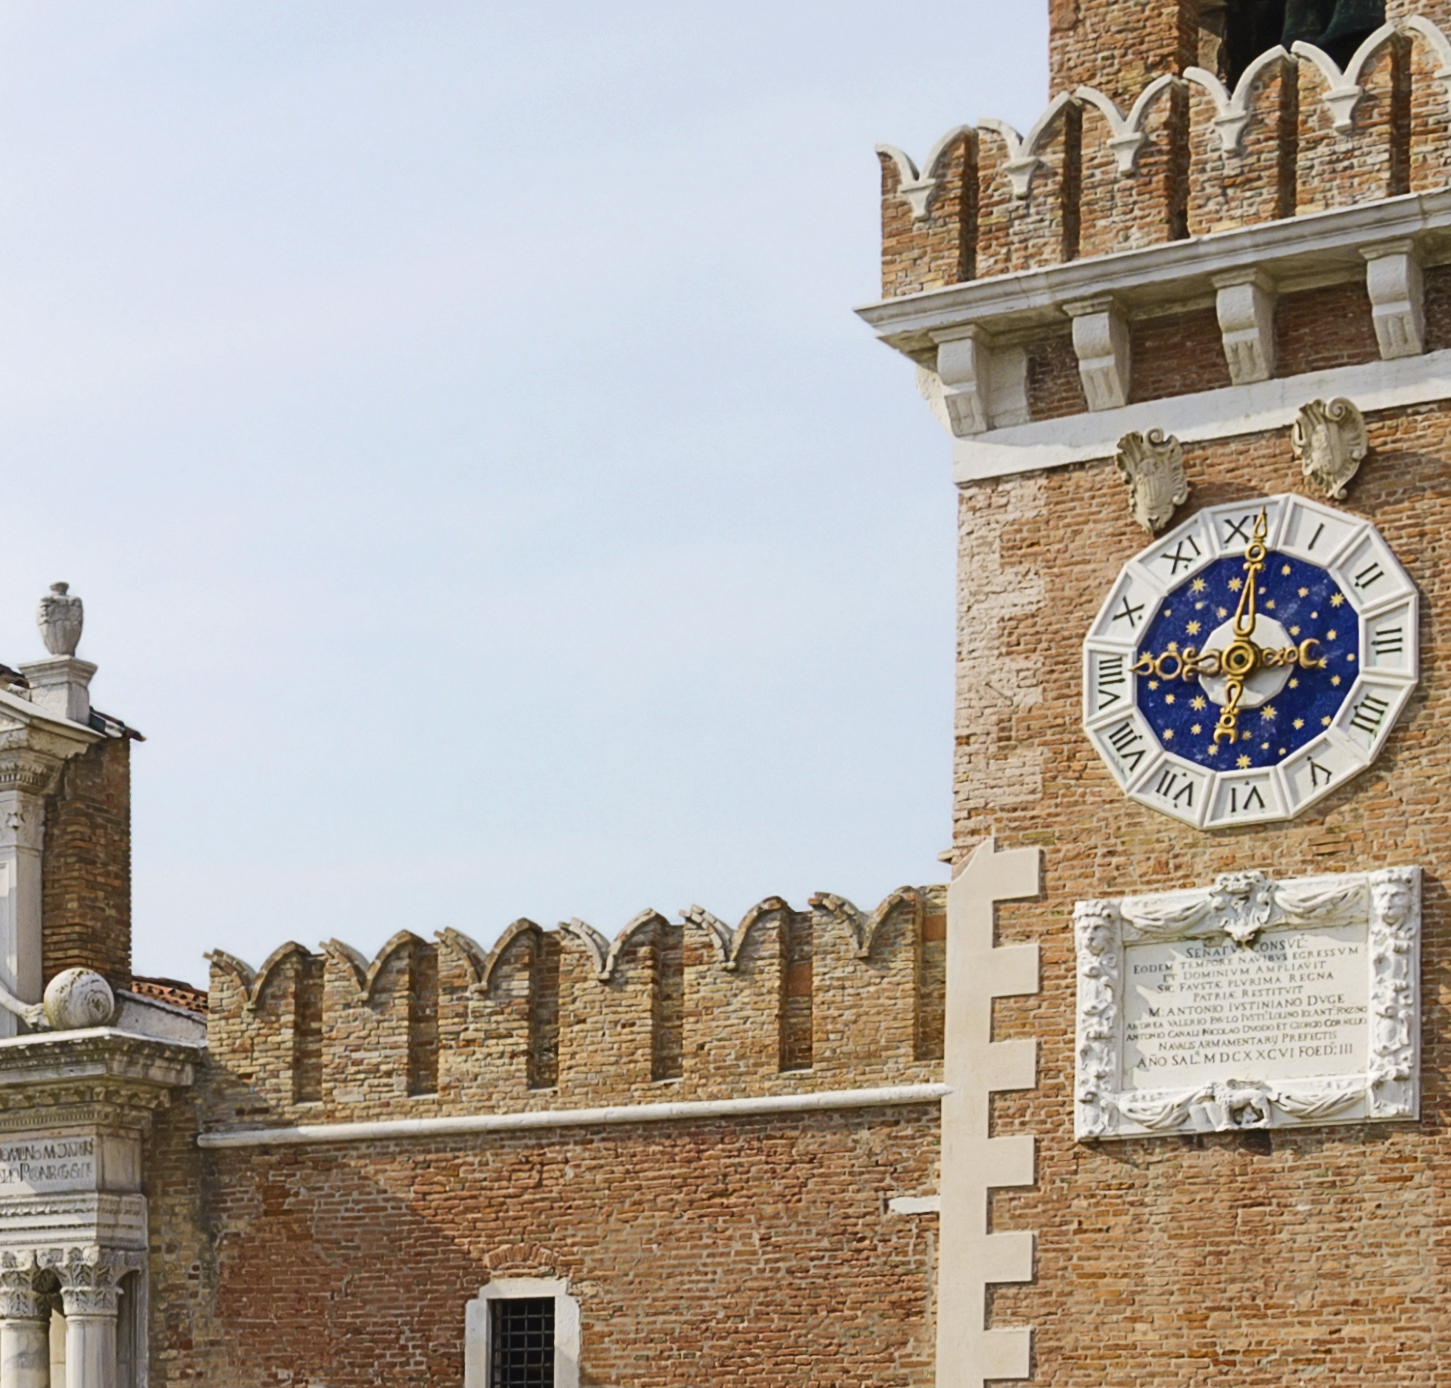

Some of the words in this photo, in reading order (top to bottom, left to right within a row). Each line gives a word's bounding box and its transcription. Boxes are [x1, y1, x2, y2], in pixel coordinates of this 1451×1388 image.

[1160, 534, 1201, 575] XI
[1354, 562, 1385, 590] II
[1112, 596, 1146, 627] X
[1372, 626, 1403, 656] III
[1306, 756, 1333, 787] V
[1230, 784, 1265, 813] VI
[1133, 963, 1174, 975] EODEM
[1179, 957, 1233, 970] TEMPORE
[1292, 946, 1359, 961] EGRESSVM
[1183, 967, 1250, 981] DOMINIVM
[1255, 960, 1327, 975] AMPLIAVIT
[1228, 975, 1282, 989] PLVRIMA
[1289, 971, 1334, 983] REGNA
[1241, 985, 1304, 999] RESTITVIT
[1228, 997, 1303, 1012] IVSTINIANO
